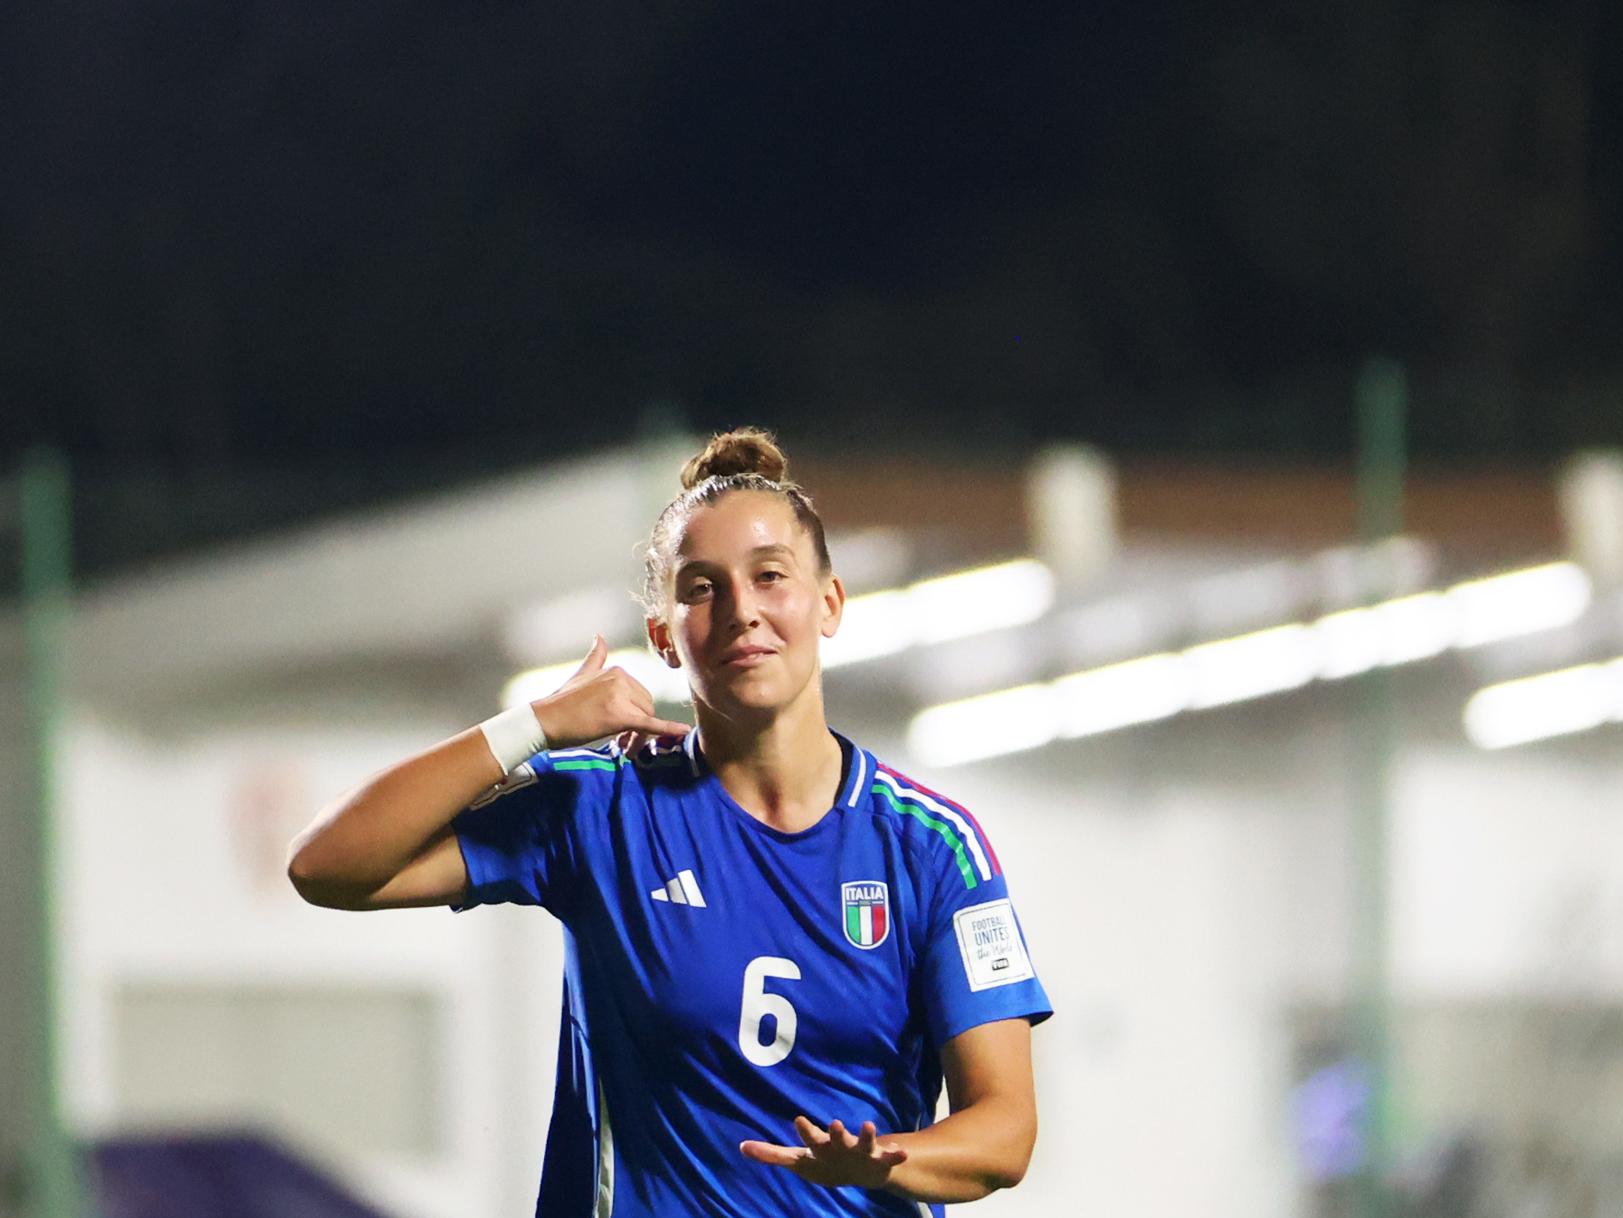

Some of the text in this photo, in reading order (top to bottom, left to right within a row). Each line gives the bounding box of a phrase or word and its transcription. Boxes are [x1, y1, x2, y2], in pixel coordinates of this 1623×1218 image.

[845, 887, 884, 900] ITALIA
[971, 916, 1007, 931] FOOTBA
[975, 926, 1009, 946] UNITES
[738, 956, 801, 1067] 6
